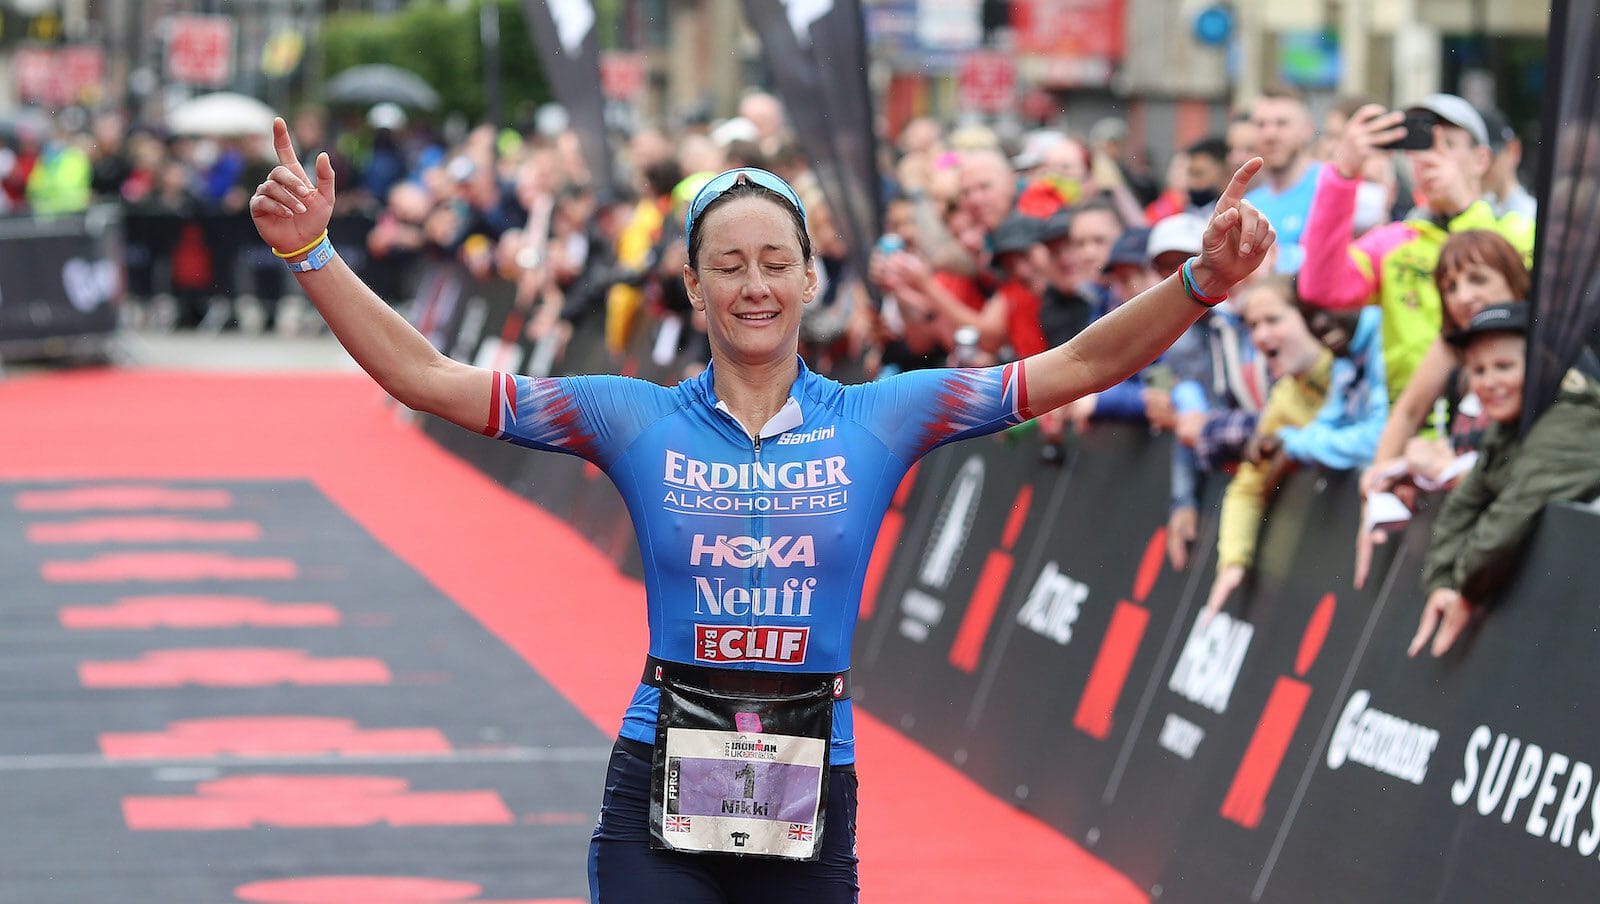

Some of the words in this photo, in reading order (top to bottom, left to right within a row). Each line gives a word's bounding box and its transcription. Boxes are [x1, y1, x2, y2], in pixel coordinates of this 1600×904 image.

[776, 425, 835, 445] Santini
[664, 449, 852, 491] ERDINGER
[664, 490, 848, 511] ALKOHOLFREI
[690, 534, 816, 568] HOKA
[693, 575, 817, 617] Neuff
[704, 629, 718, 658] BAR
[719, 629, 803, 660] CLIF
[731, 739, 777, 753] IRONMAN
[731, 750, 743, 758] UK
[669, 770, 678, 800] FPRO
[735, 763, 755, 799] 1
[1451, 724, 1600, 861] SUPERS
[721, 800, 769, 816] Nikki
